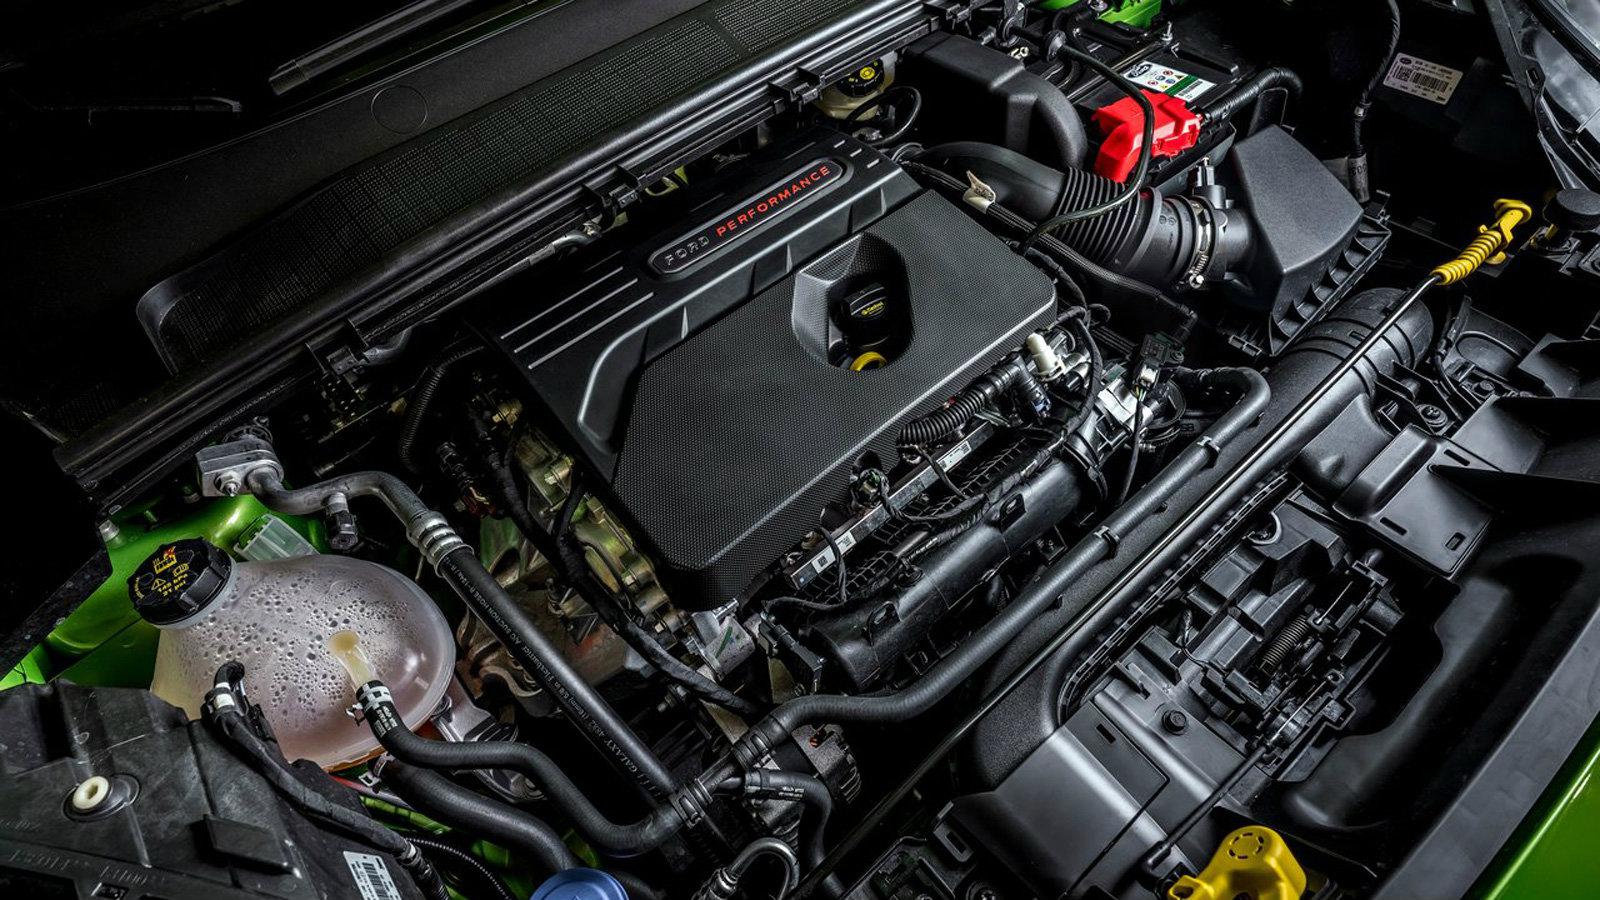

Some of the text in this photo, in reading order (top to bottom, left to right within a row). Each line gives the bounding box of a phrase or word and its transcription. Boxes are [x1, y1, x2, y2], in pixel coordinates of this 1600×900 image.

[665, 165, 831, 266] FORD PERFORMANCE
[472, 590, 490, 609] HOSE
[485, 606, 512, 634] SUCTION
[603, 736, 638, 774] GALAXY
